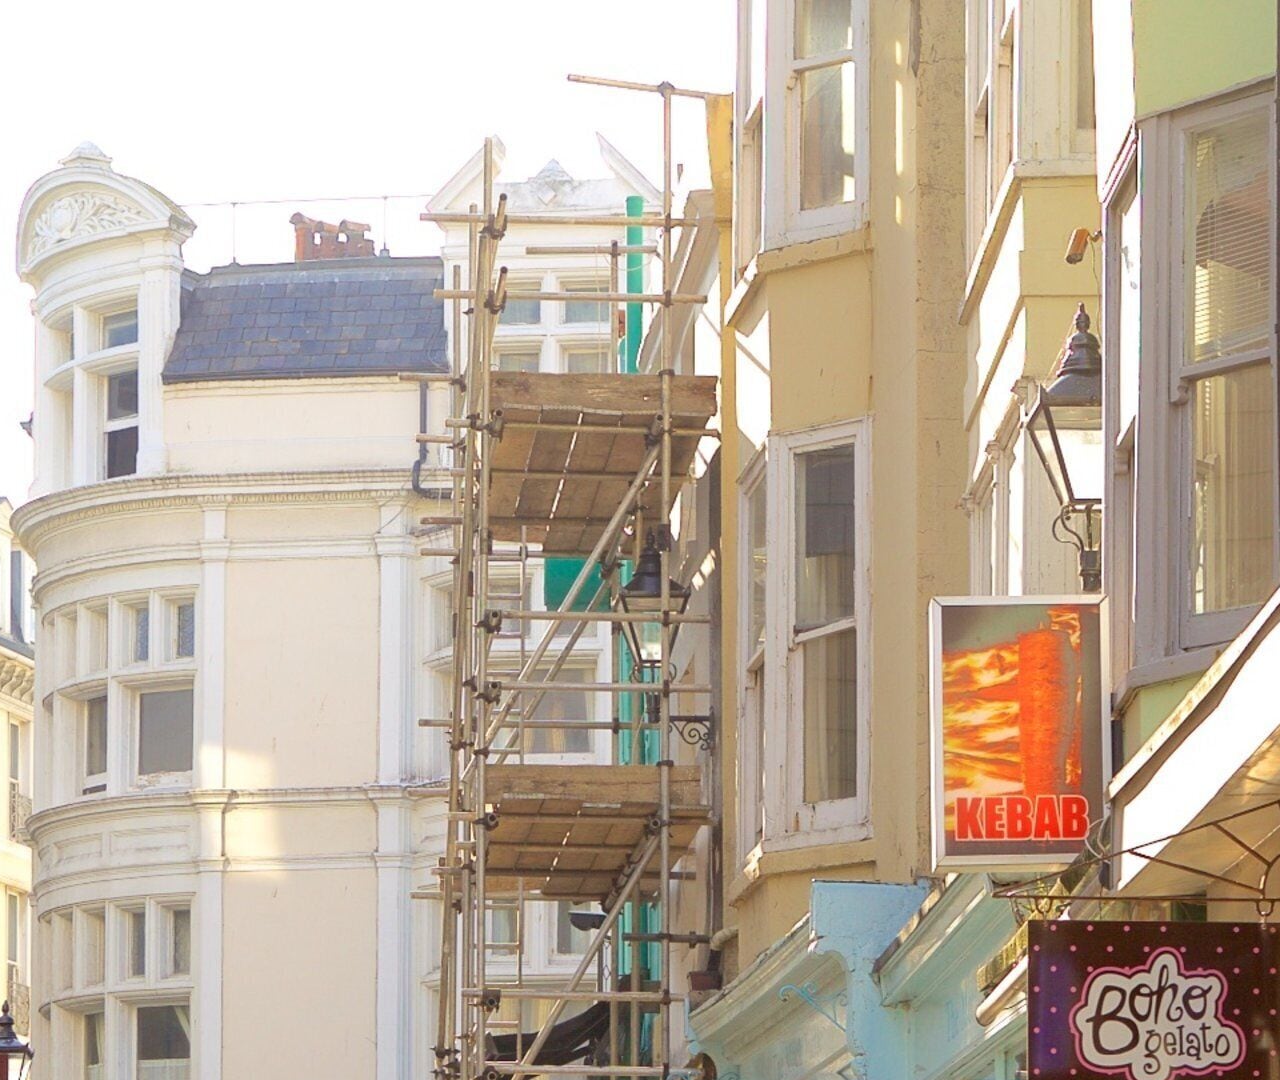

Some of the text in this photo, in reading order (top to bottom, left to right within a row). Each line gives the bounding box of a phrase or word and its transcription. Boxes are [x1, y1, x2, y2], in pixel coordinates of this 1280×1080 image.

[955, 795, 1090, 841] KEBAB
[1086, 964, 1213, 1056] Boho
[1146, 1022, 1232, 1075] gelato
